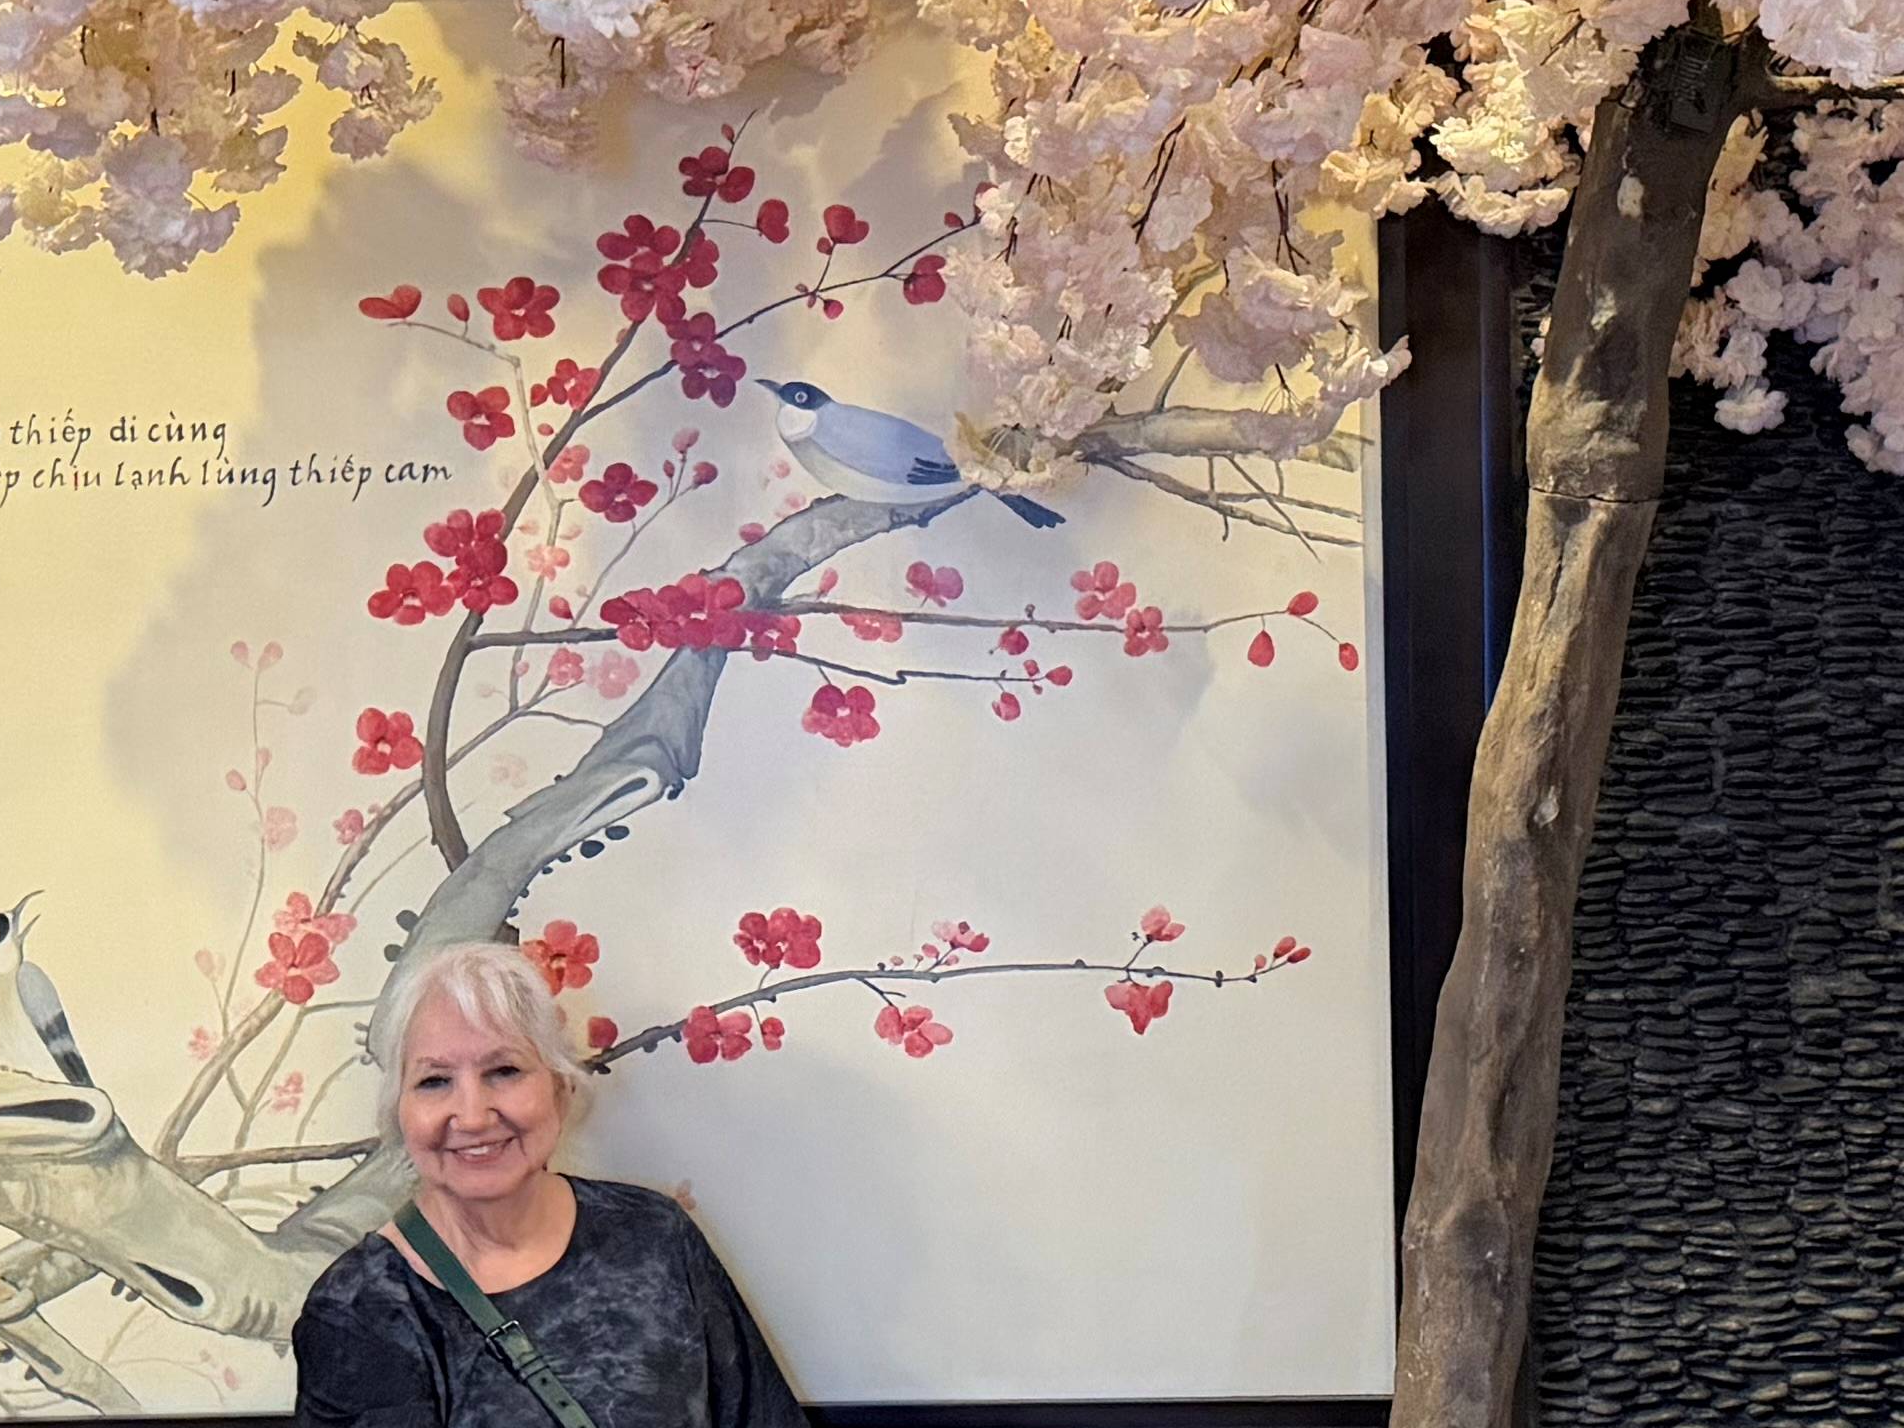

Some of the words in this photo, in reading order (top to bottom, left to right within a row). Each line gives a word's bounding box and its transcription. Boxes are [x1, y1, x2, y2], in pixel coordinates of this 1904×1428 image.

[9, 407, 92, 467] thiếp
[147, 410, 227, 461] cùng
[114, 455, 191, 491] lạnh
[201, 456, 277, 508] lùng
[288, 452, 372, 502] thiếp
[384, 461, 453, 484] cam
